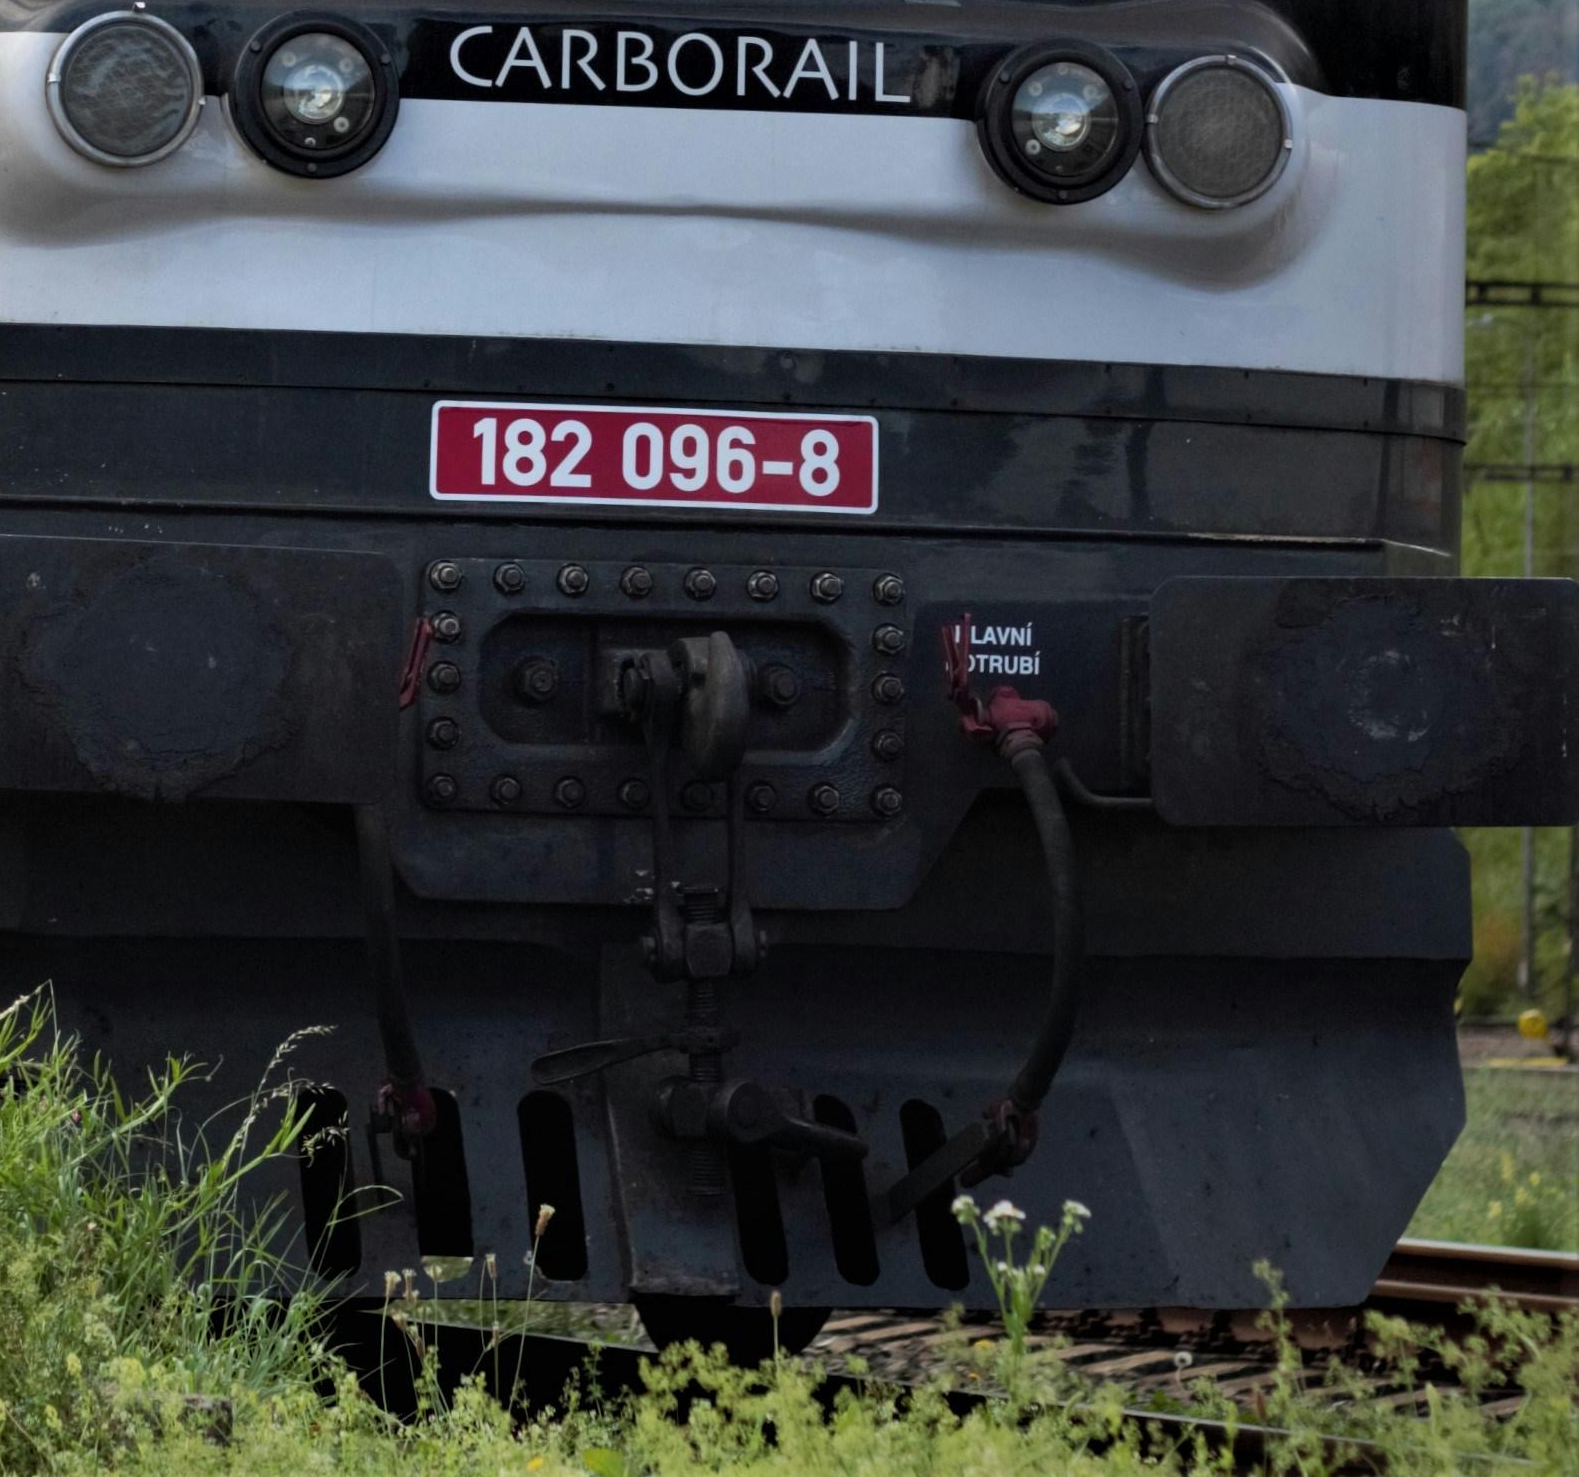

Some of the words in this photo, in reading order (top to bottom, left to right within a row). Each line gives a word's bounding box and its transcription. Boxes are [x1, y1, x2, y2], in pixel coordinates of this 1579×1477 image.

[449, 25, 911, 105] CARBORAIL
[472, 416, 593, 488] 182
[621, 421, 841, 498] 096-8
